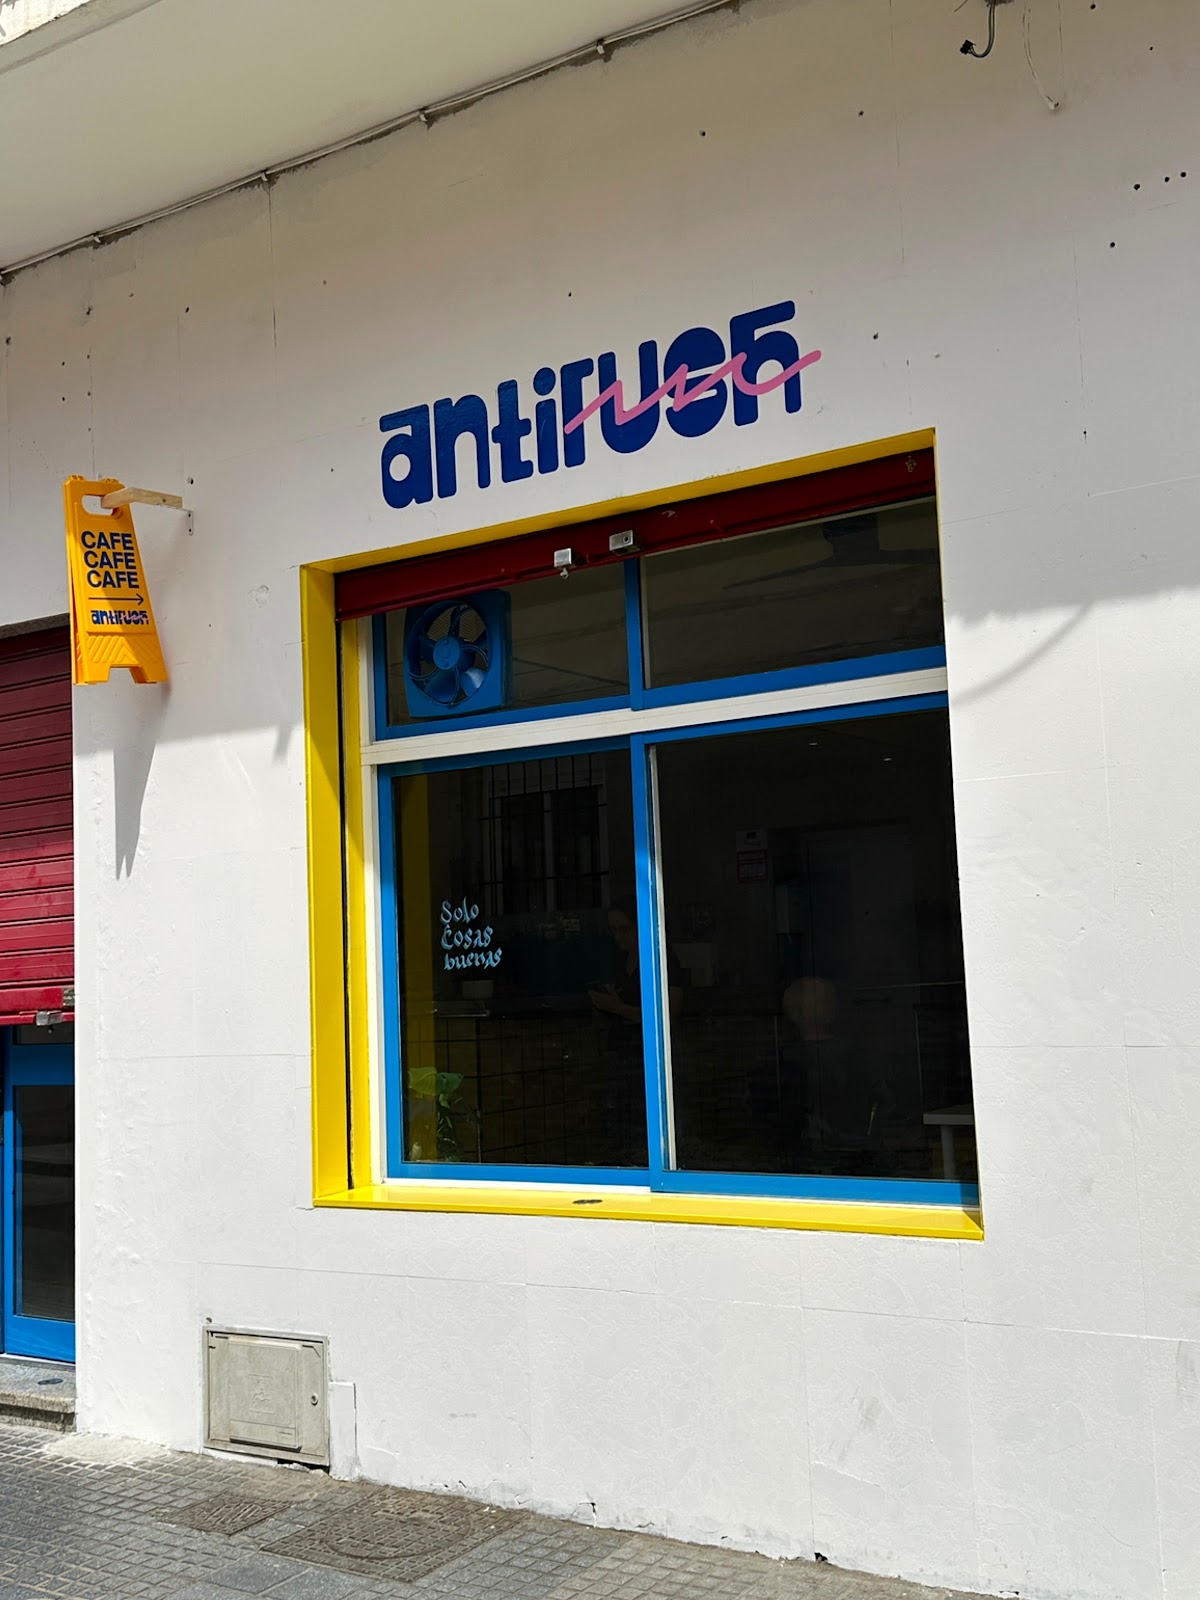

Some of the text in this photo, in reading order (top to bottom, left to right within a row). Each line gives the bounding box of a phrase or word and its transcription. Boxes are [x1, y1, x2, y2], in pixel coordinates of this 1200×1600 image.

[380, 301, 802, 509] antirush
[81, 531, 134, 551] CAFE
[84, 551, 137, 570] CAFE
[87, 570, 140, 589] CAFE
[440, 897, 480, 924] Solo
[444, 947, 503, 971] buenas
